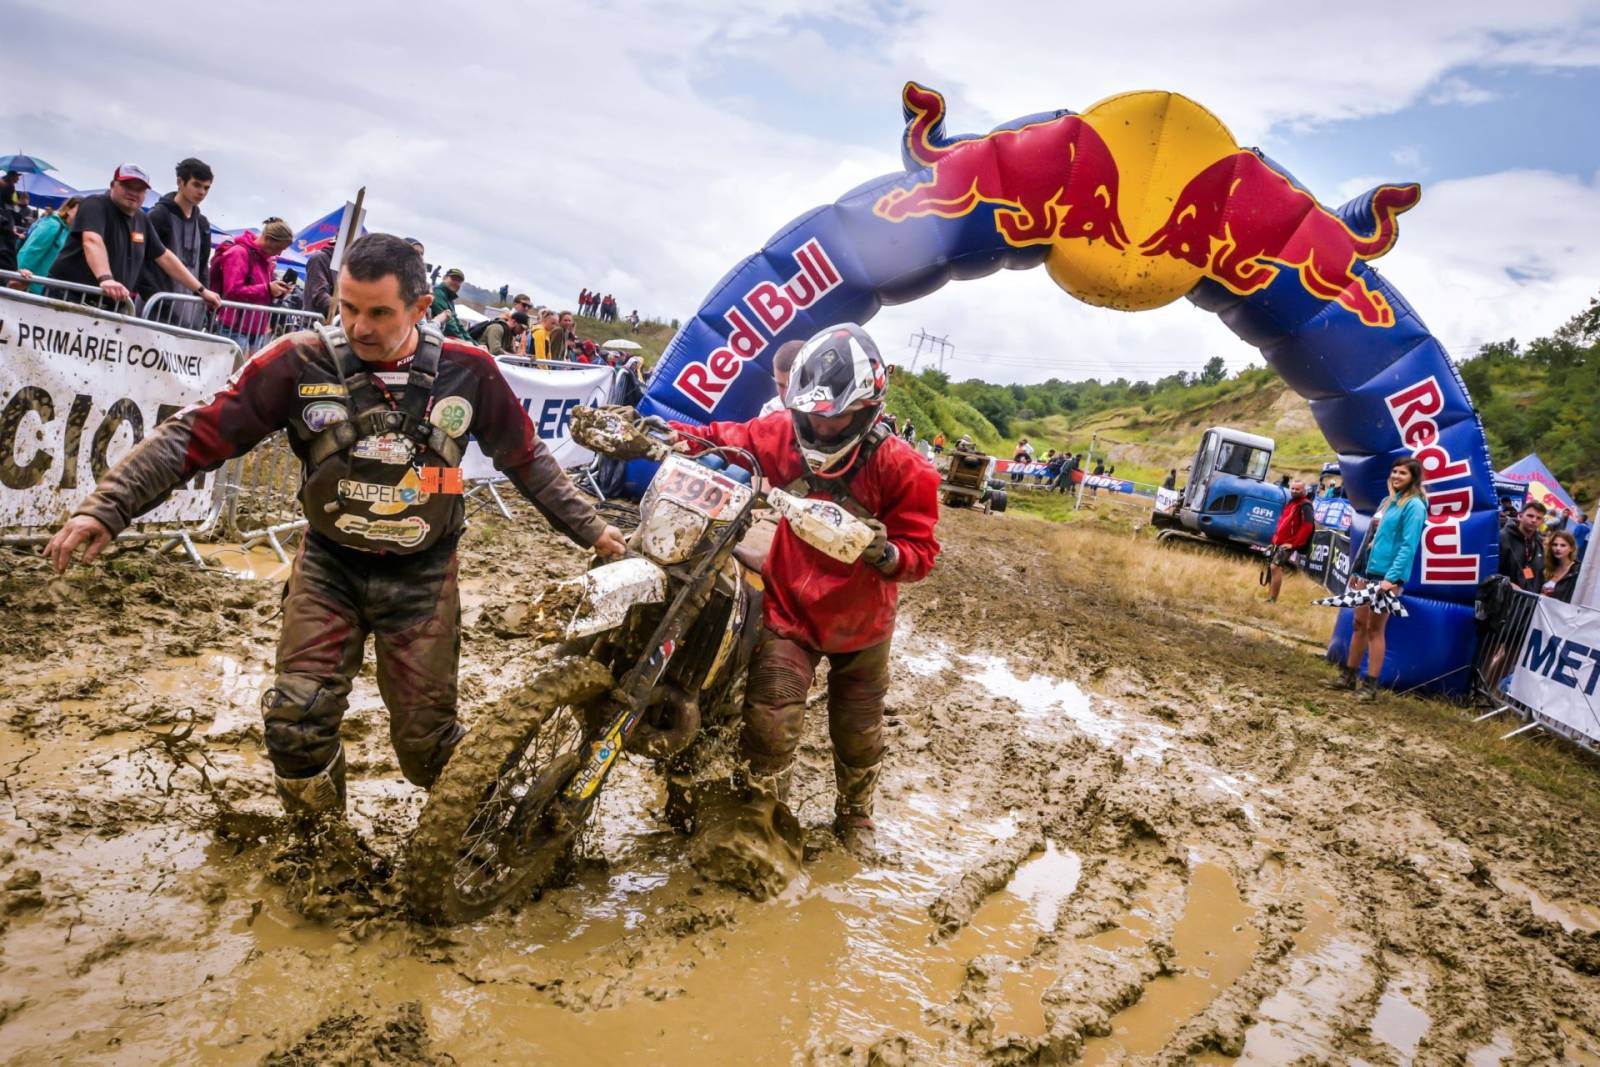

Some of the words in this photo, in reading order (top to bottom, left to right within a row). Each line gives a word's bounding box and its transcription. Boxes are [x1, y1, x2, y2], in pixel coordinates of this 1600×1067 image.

[17, 322, 122, 363] PRIMĂRIEI
[127, 344, 201, 377] COMUNEI
[677, 311, 766, 409] Red
[747, 241, 839, 333] Bull
[1390, 379, 1470, 481] Red
[1006, 463, 1048, 475] 100%
[1252, 506, 1274, 518] GFH
[1424, 490, 1477, 582] Bull
